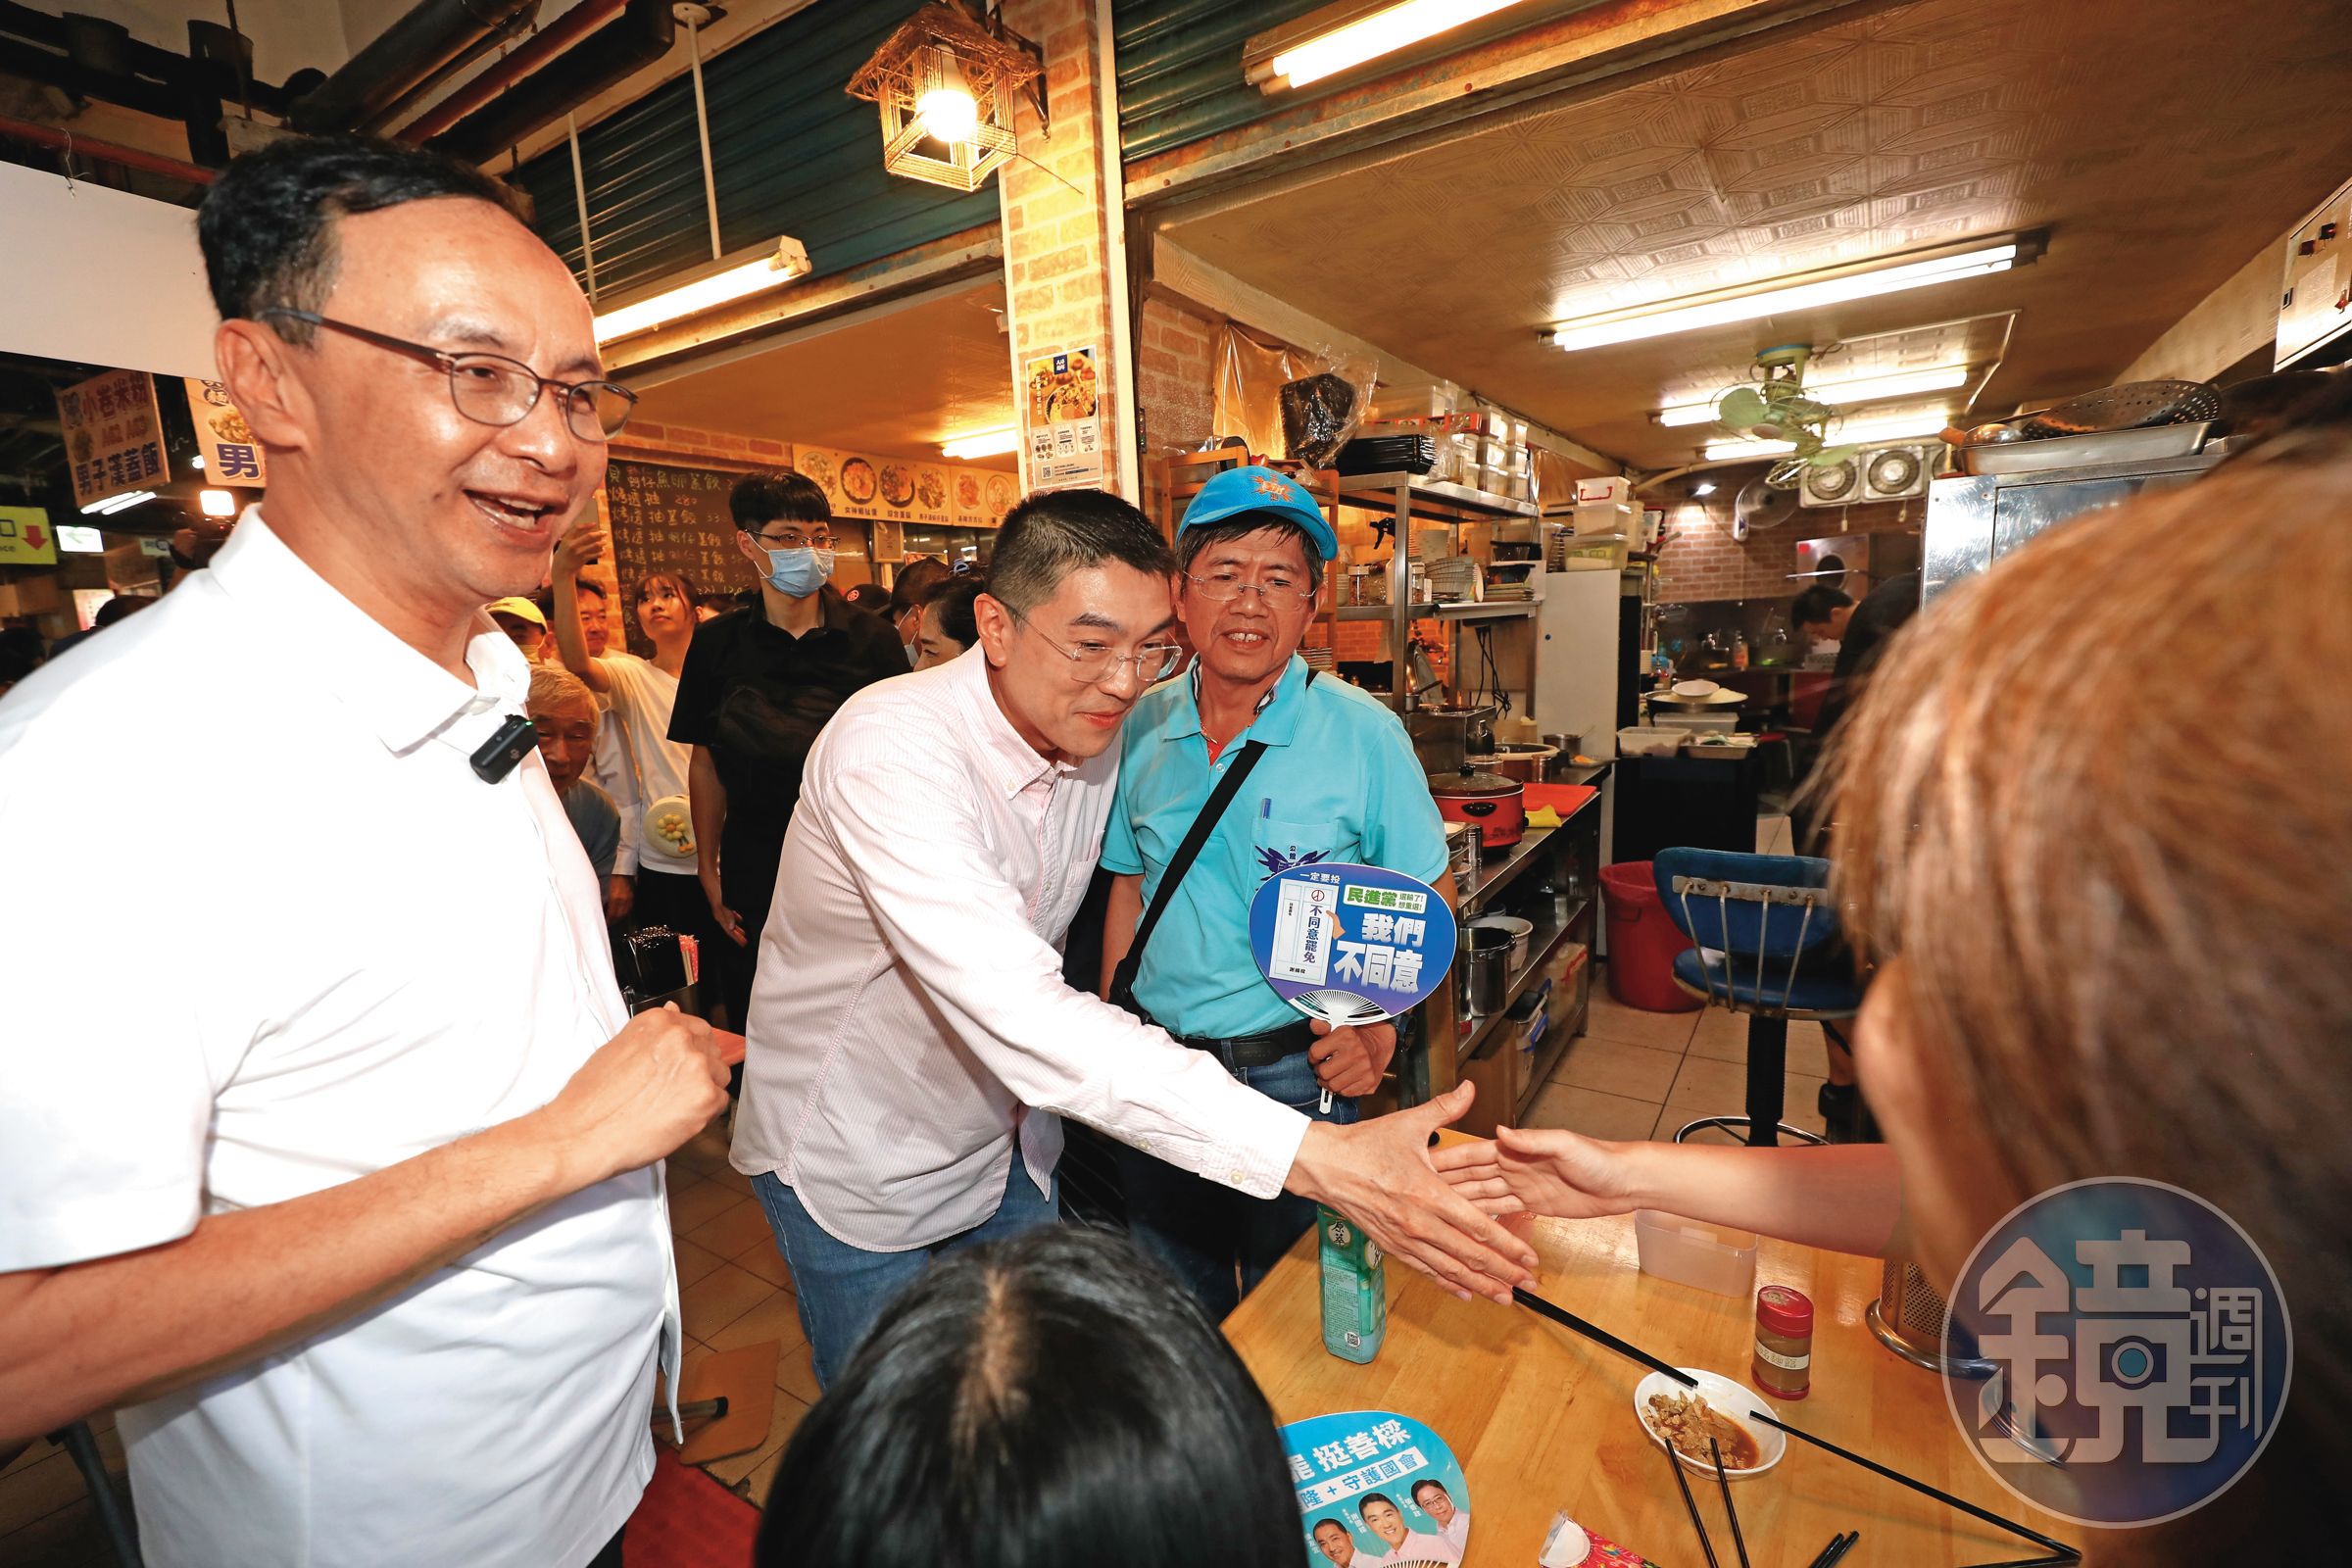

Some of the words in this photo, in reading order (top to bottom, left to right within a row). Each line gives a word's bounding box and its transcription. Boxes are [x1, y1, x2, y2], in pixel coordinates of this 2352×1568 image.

[217, 444, 259, 478] 男
[1299, 871, 1342, 884] 一定要投
[1347, 886, 1397, 907] 民進黨
[1302, 904, 1323, 964] 不同意罷免
[1361, 911, 1427, 948] 我們
[1333, 940, 1423, 993] 不同意
[1342, 1452, 1418, 1492] 守護國會
